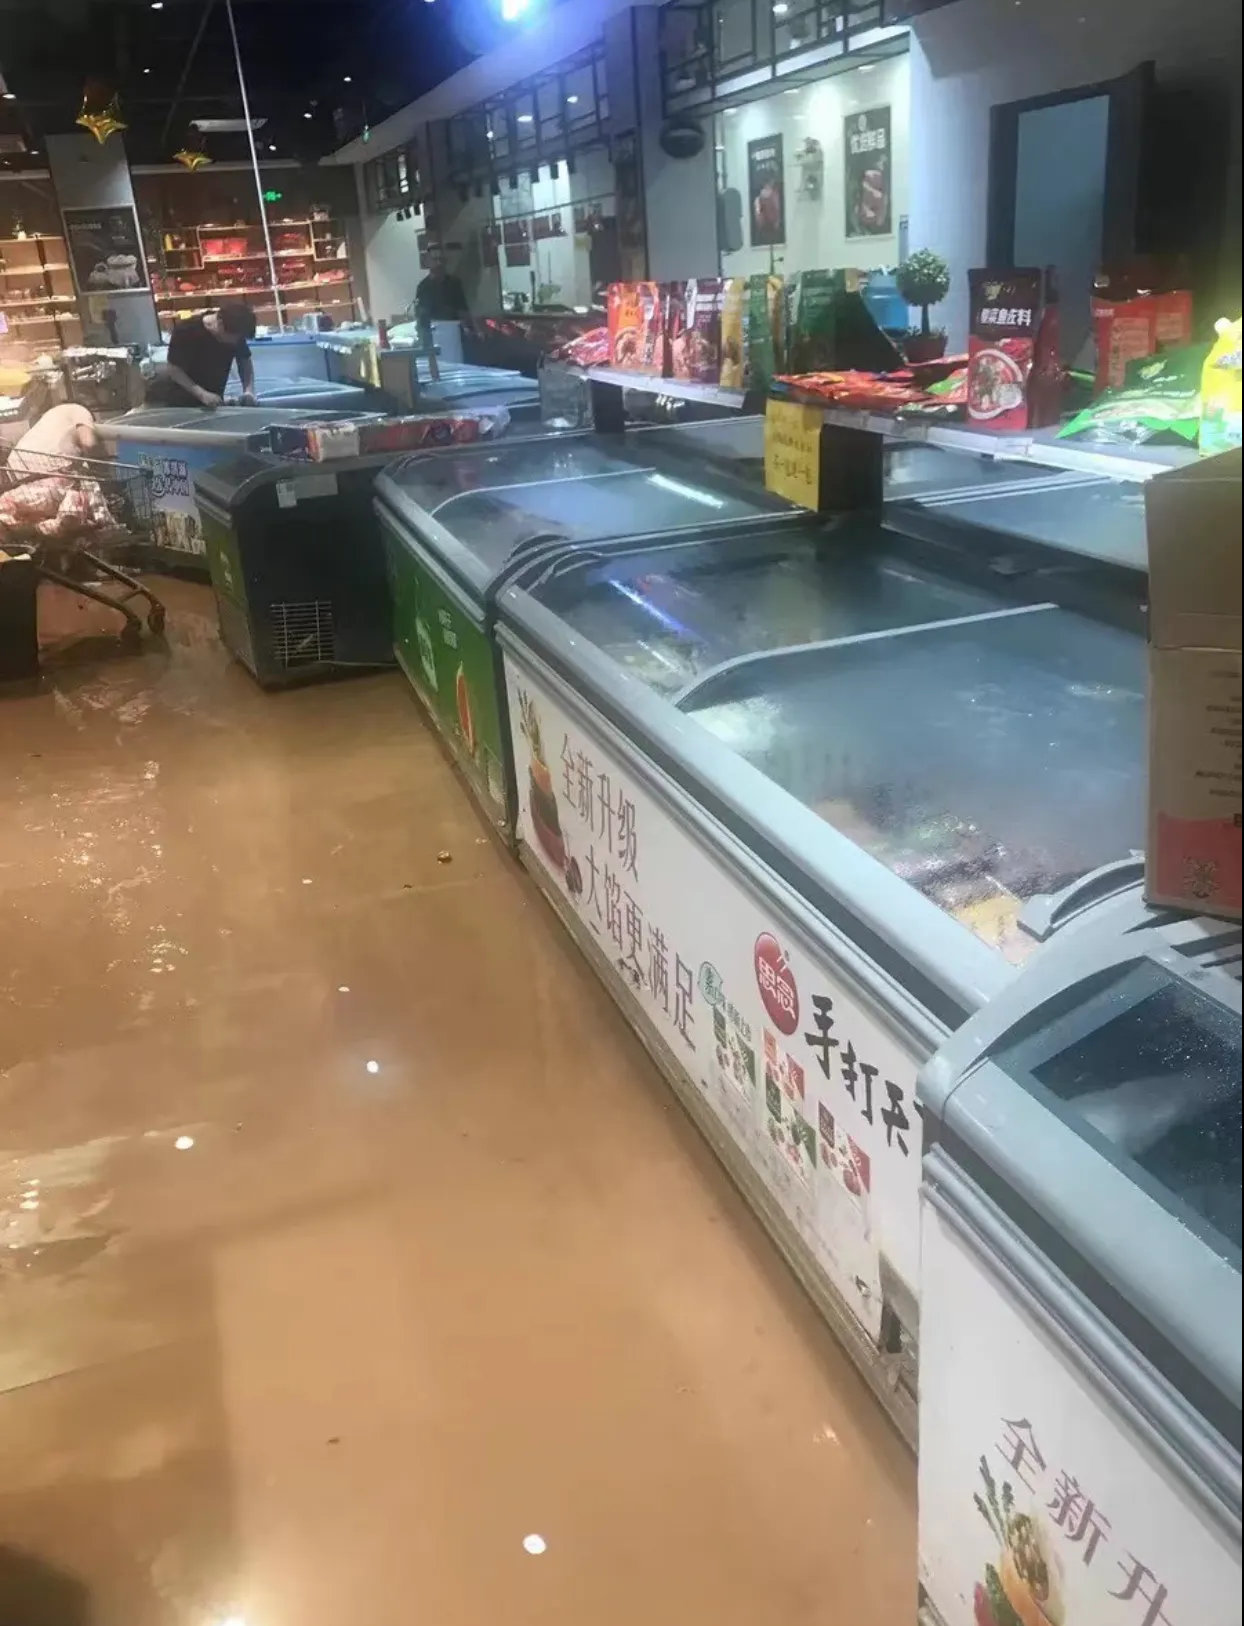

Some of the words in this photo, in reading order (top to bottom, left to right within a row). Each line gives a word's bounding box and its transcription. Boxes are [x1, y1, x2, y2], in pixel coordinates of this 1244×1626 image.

[560, 733, 639, 882] 全新升级
[585, 844, 697, 1049] 大馅更满足
[804, 993, 924, 1158] 手打天
[994, 1416, 1174, 1626] 全新升
